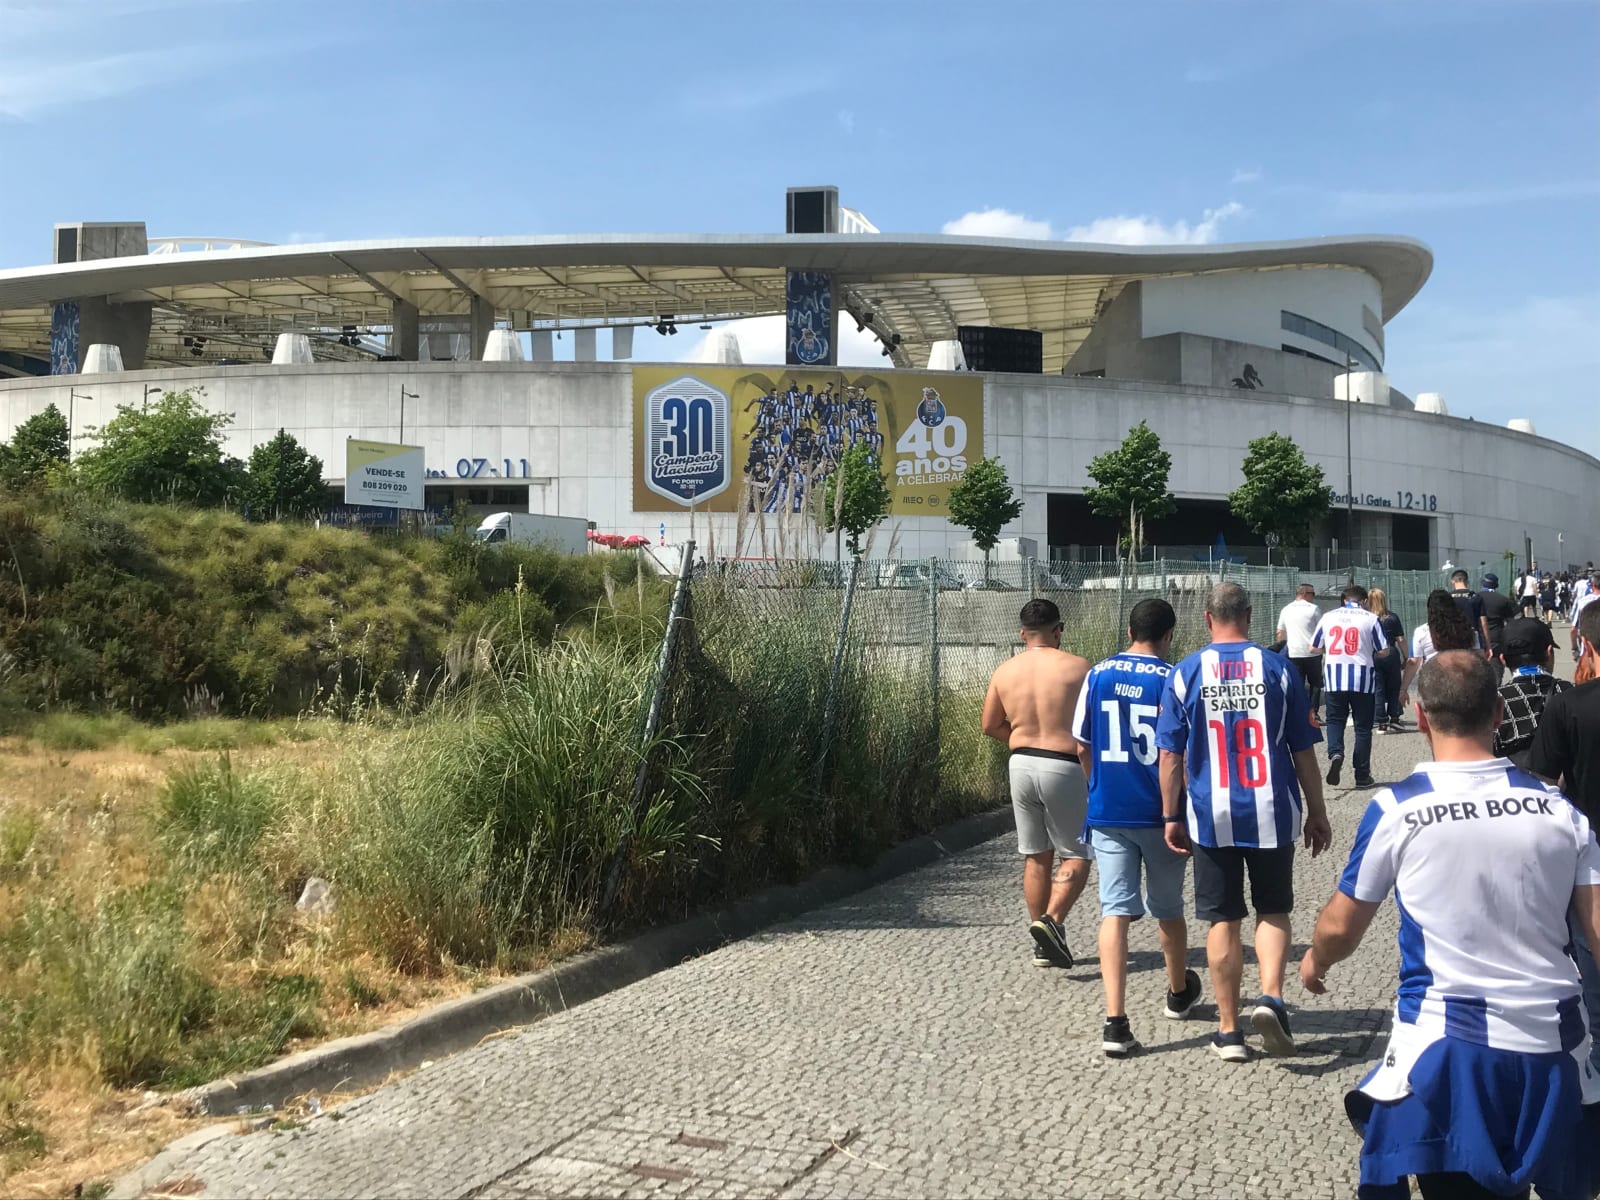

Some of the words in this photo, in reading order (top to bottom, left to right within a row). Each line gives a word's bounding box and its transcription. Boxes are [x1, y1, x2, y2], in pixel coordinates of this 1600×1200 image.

[663, 398, 712, 458] 30
[896, 416, 967, 458] 40
[365, 467, 406, 478] VENDE-SE
[425, 467, 446, 479] tes
[456, 458, 526, 479] 07-11
[895, 456, 967, 476] anos
[896, 476, 905, 486] A
[1366, 494, 1391, 507] Gates
[1397, 491, 1437, 512] 12-18
[1328, 625, 1360, 656] 29
[1094, 660, 1132, 675] SUPER
[1211, 661, 1253, 679] VITOR
[1115, 682, 1143, 698] HUGO
[1211, 698, 1259, 711] SANTO
[1101, 700, 1158, 766] 15
[1209, 718, 1267, 789] 18
[1404, 801, 1480, 831] SUPER
[1485, 796, 1554, 818] BOCK
